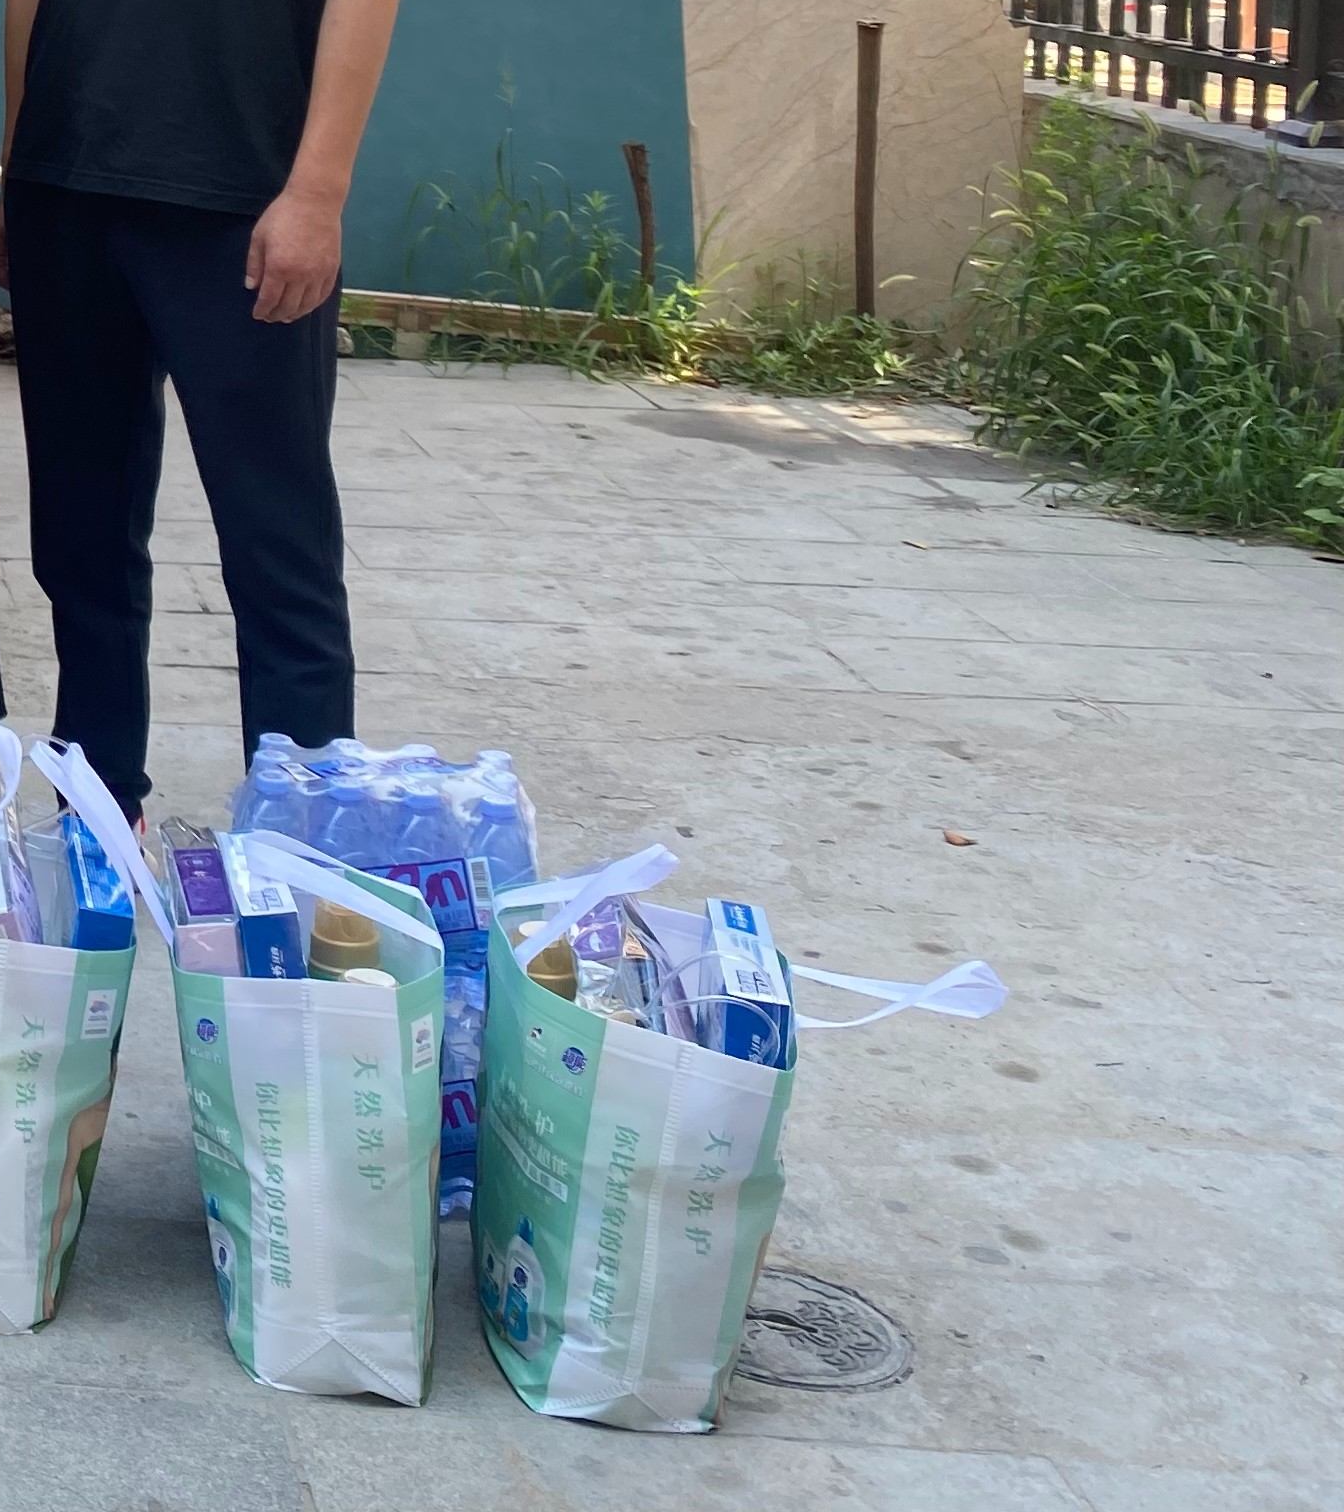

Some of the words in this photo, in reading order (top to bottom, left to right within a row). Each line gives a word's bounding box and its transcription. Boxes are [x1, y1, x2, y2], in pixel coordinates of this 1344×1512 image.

[14, 1013, 46, 1144] 天然洗护
[352, 1053, 387, 1191] 天然洗护
[254, 1080, 293, 1290] 你比想象的更超能
[587, 1124, 641, 1330] 你比想象的更超能
[684, 1128, 734, 1256] 天然洗护
